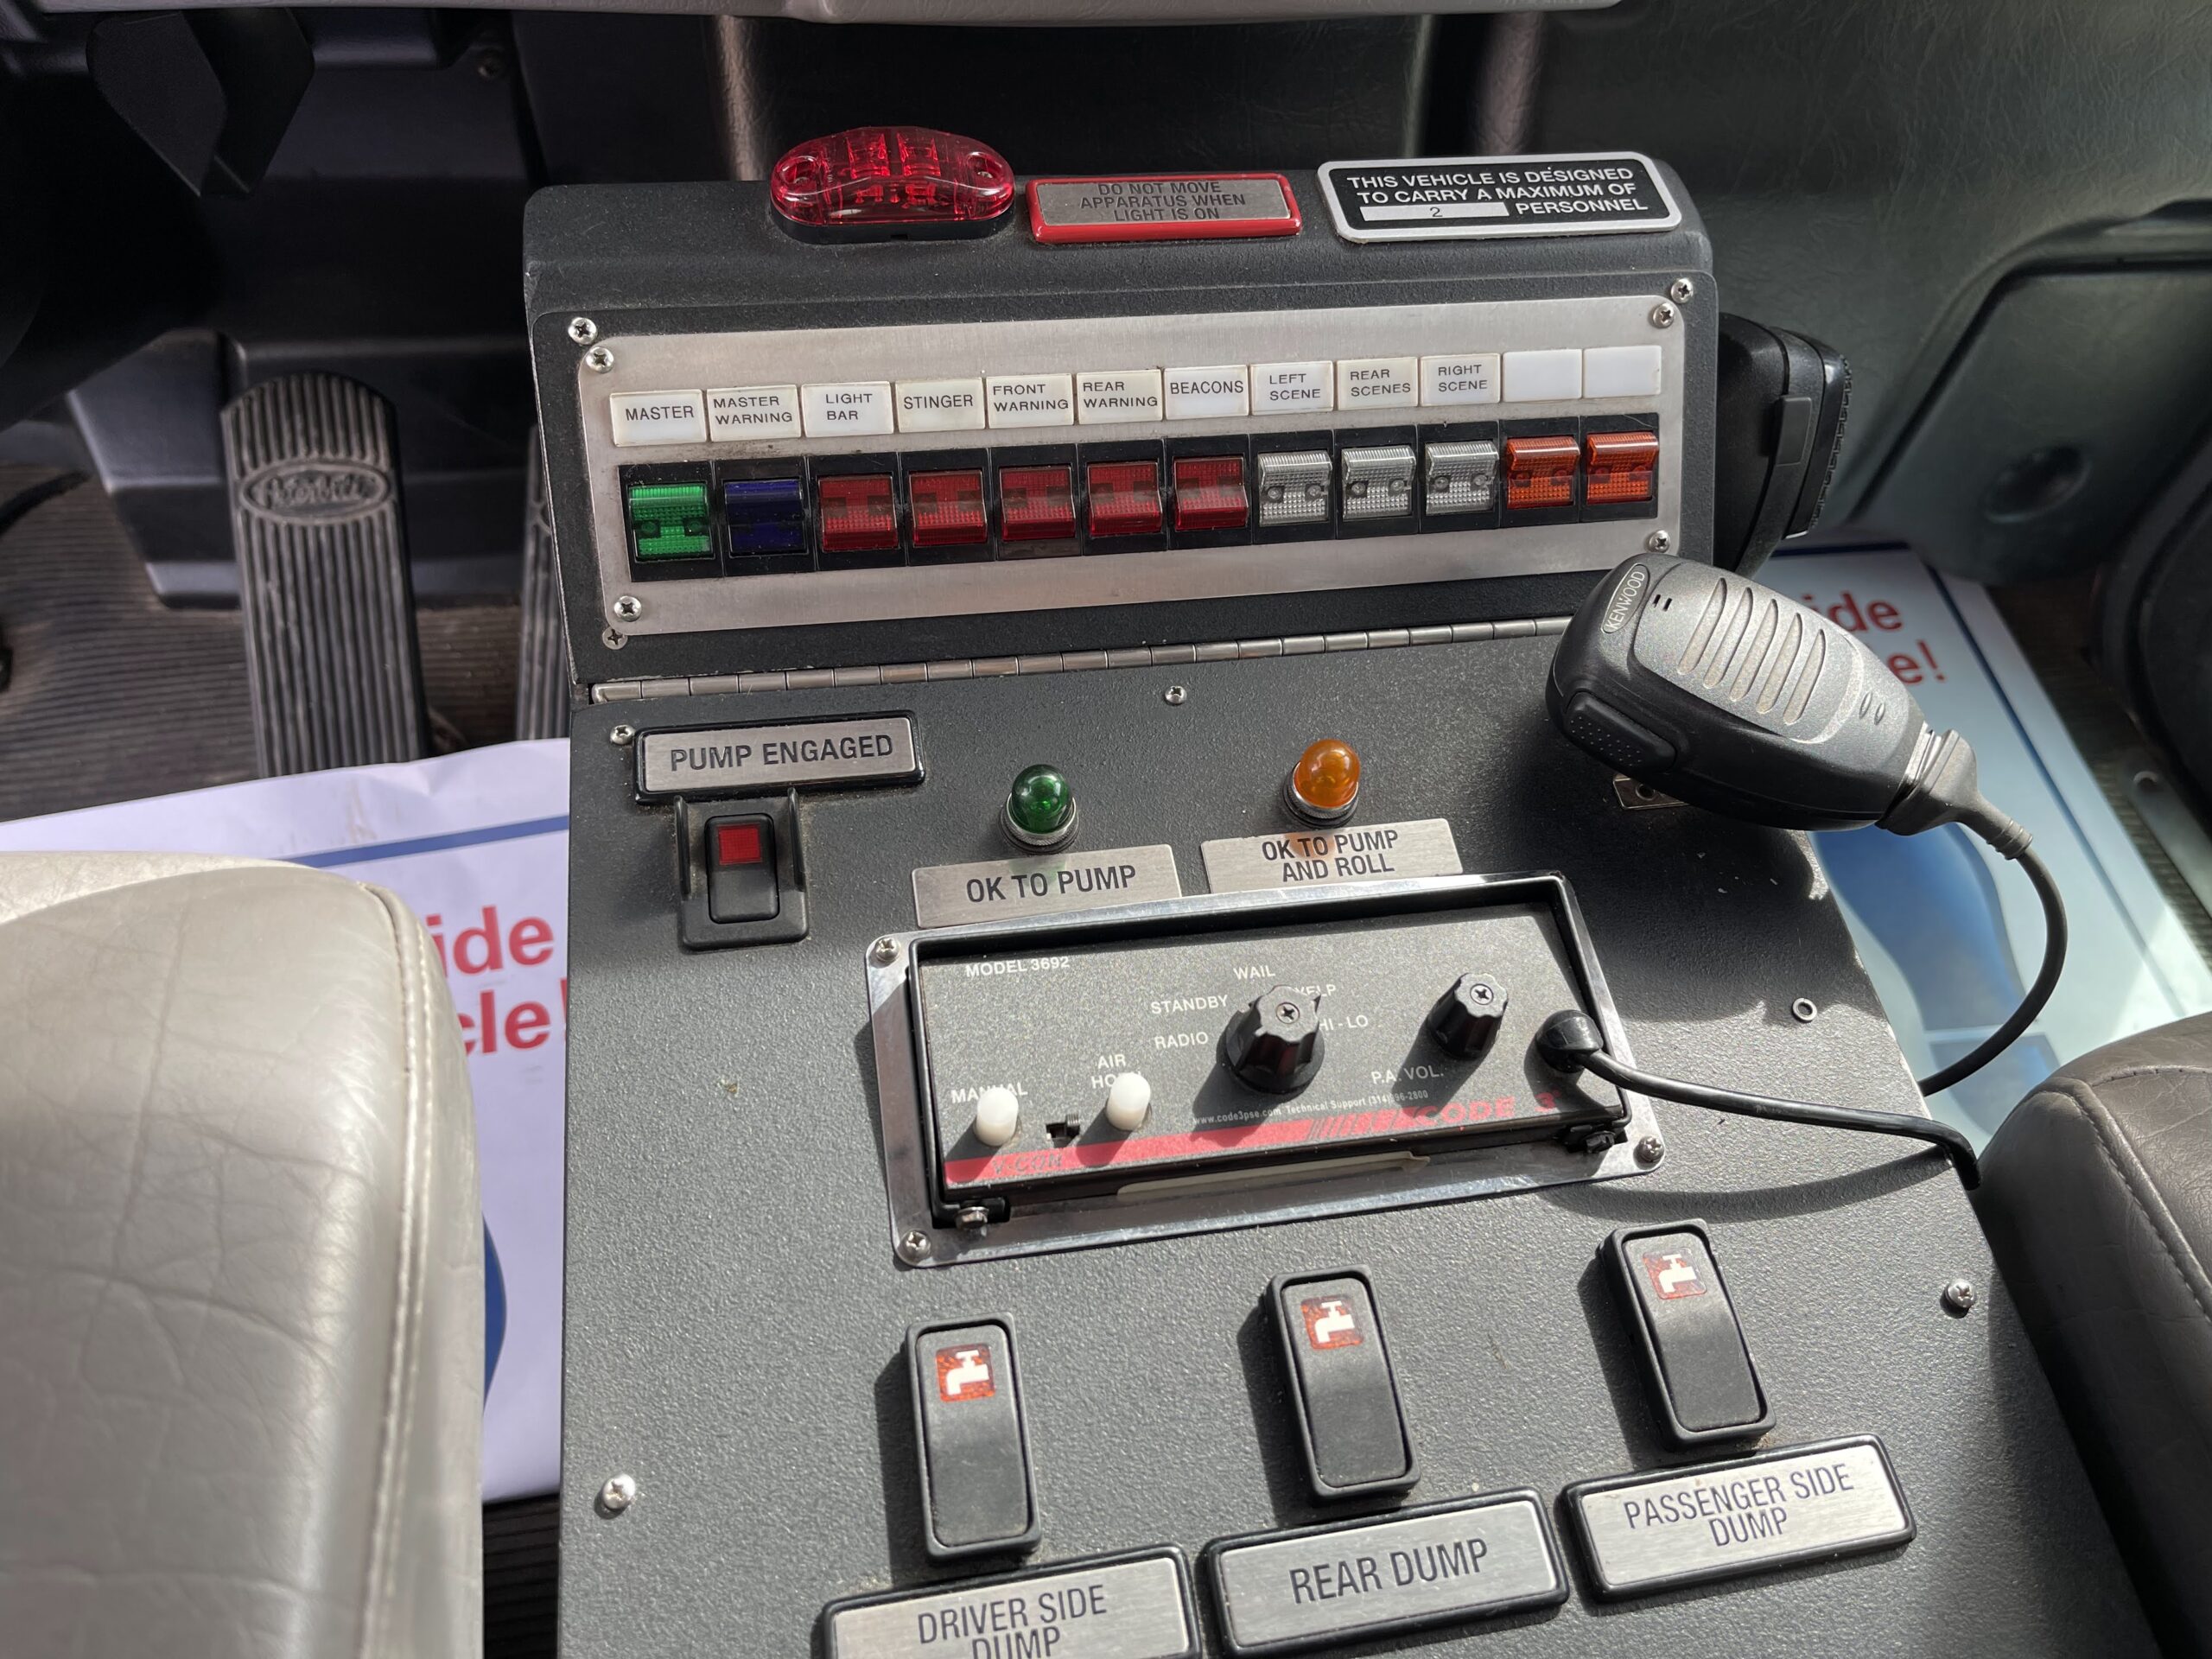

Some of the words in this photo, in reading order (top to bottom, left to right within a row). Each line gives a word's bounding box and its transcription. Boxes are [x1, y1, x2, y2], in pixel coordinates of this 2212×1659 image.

[1346, 175, 1398, 189] THIS
[1402, 171, 1496, 188] VEHICLE
[1499, 171, 1520, 184] IS
[1524, 168, 1634, 183] DESIGNED
[1097, 182, 1122, 196] DO
[1128, 182, 1166, 195] NOT
[1170, 181, 1222, 194] MOVE
[1357, 192, 1388, 205] TO
[1394, 187, 1471, 204] CARRY
[1477, 188, 1492, 200] A
[1495, 184, 1605, 200] MAXIMUM
[1607, 182, 1637, 196] OF
[1080, 194, 1187, 209] APPARATUS
[1192, 194, 1246, 207] WHEN
[1430, 207, 1443, 218] 2
[1516, 199, 1649, 215] PERSONNEL
[1114, 208, 1166, 222] LIGHT
[1171, 208, 1190, 221] IS
[1193, 207, 1219, 219] ON
[1269, 373, 1307, 385] LEFT
[1350, 368, 1390, 381] REAR
[1438, 364, 1483, 377] RIGHT
[993, 384, 1046, 396] FRONT
[1083, 381, 1125, 392] REAR
[1170, 380, 1244, 395] BEACONS
[1351, 382, 1412, 397] SCENES
[1438, 378, 1489, 392] SCENE
[713, 396, 780, 409] MASTER
[825, 392, 874, 404] LIGHT
[903, 394, 974, 410] STINGER
[1083, 396, 1159, 409] WARNING
[1269, 388, 1321, 402] SCENE
[625, 405, 695, 422] MASTER
[994, 399, 1070, 412] WARNING
[715, 411, 793, 425] WARNING
[827, 410, 859, 421] BAR
[1605, 571, 1645, 630] KENWOOD
[671, 744, 752, 772] PUMP
[762, 734, 893, 766] ENGAGED
[1261, 839, 1293, 862] OK
[1296, 835, 1330, 858] TO
[1334, 829, 1399, 854] PUMP
[1281, 859, 1331, 883] AND
[1335, 852, 1395, 877] ROLL
[966, 874, 1005, 904] OK
[1011, 871, 1049, 899] TO
[1058, 864, 1137, 896] PUMP
[965, 959, 1027, 978] MODEL
[1031, 957, 1070, 972] 3692
[1233, 964, 1275, 980] WAIL
[1150, 994, 1229, 1014] STANDBY
[1154, 1031, 1210, 1050] RADIO
[1097, 1054, 1127, 1070] AIR
[1090, 1071, 1141, 1089] HO
[1371, 1071, 1402, 1084] P.A.
[1403, 1065, 1444, 1080] VOL.
[950, 1081, 1028, 1103] MAAL
[1192, 1107, 1281, 1124] www.code3pse.com
[1286, 1102, 1328, 1116] Technical
[1331, 1098, 1366, 1110] Support
[1414, 1096, 1515, 1126] CODE
[1624, 1477, 1786, 1529] PASSENGER
[1789, 1463, 1853, 1499] SIDE
[1709, 1507, 1787, 1547] DUMP
[1290, 1558, 1382, 1606] REAR
[1389, 1538, 1489, 1586] DUMP
[918, 1598, 1028, 1643] DRIVER
[1039, 1584, 1107, 1624] SIDE
[971, 1625, 1060, 1659] DUMP
